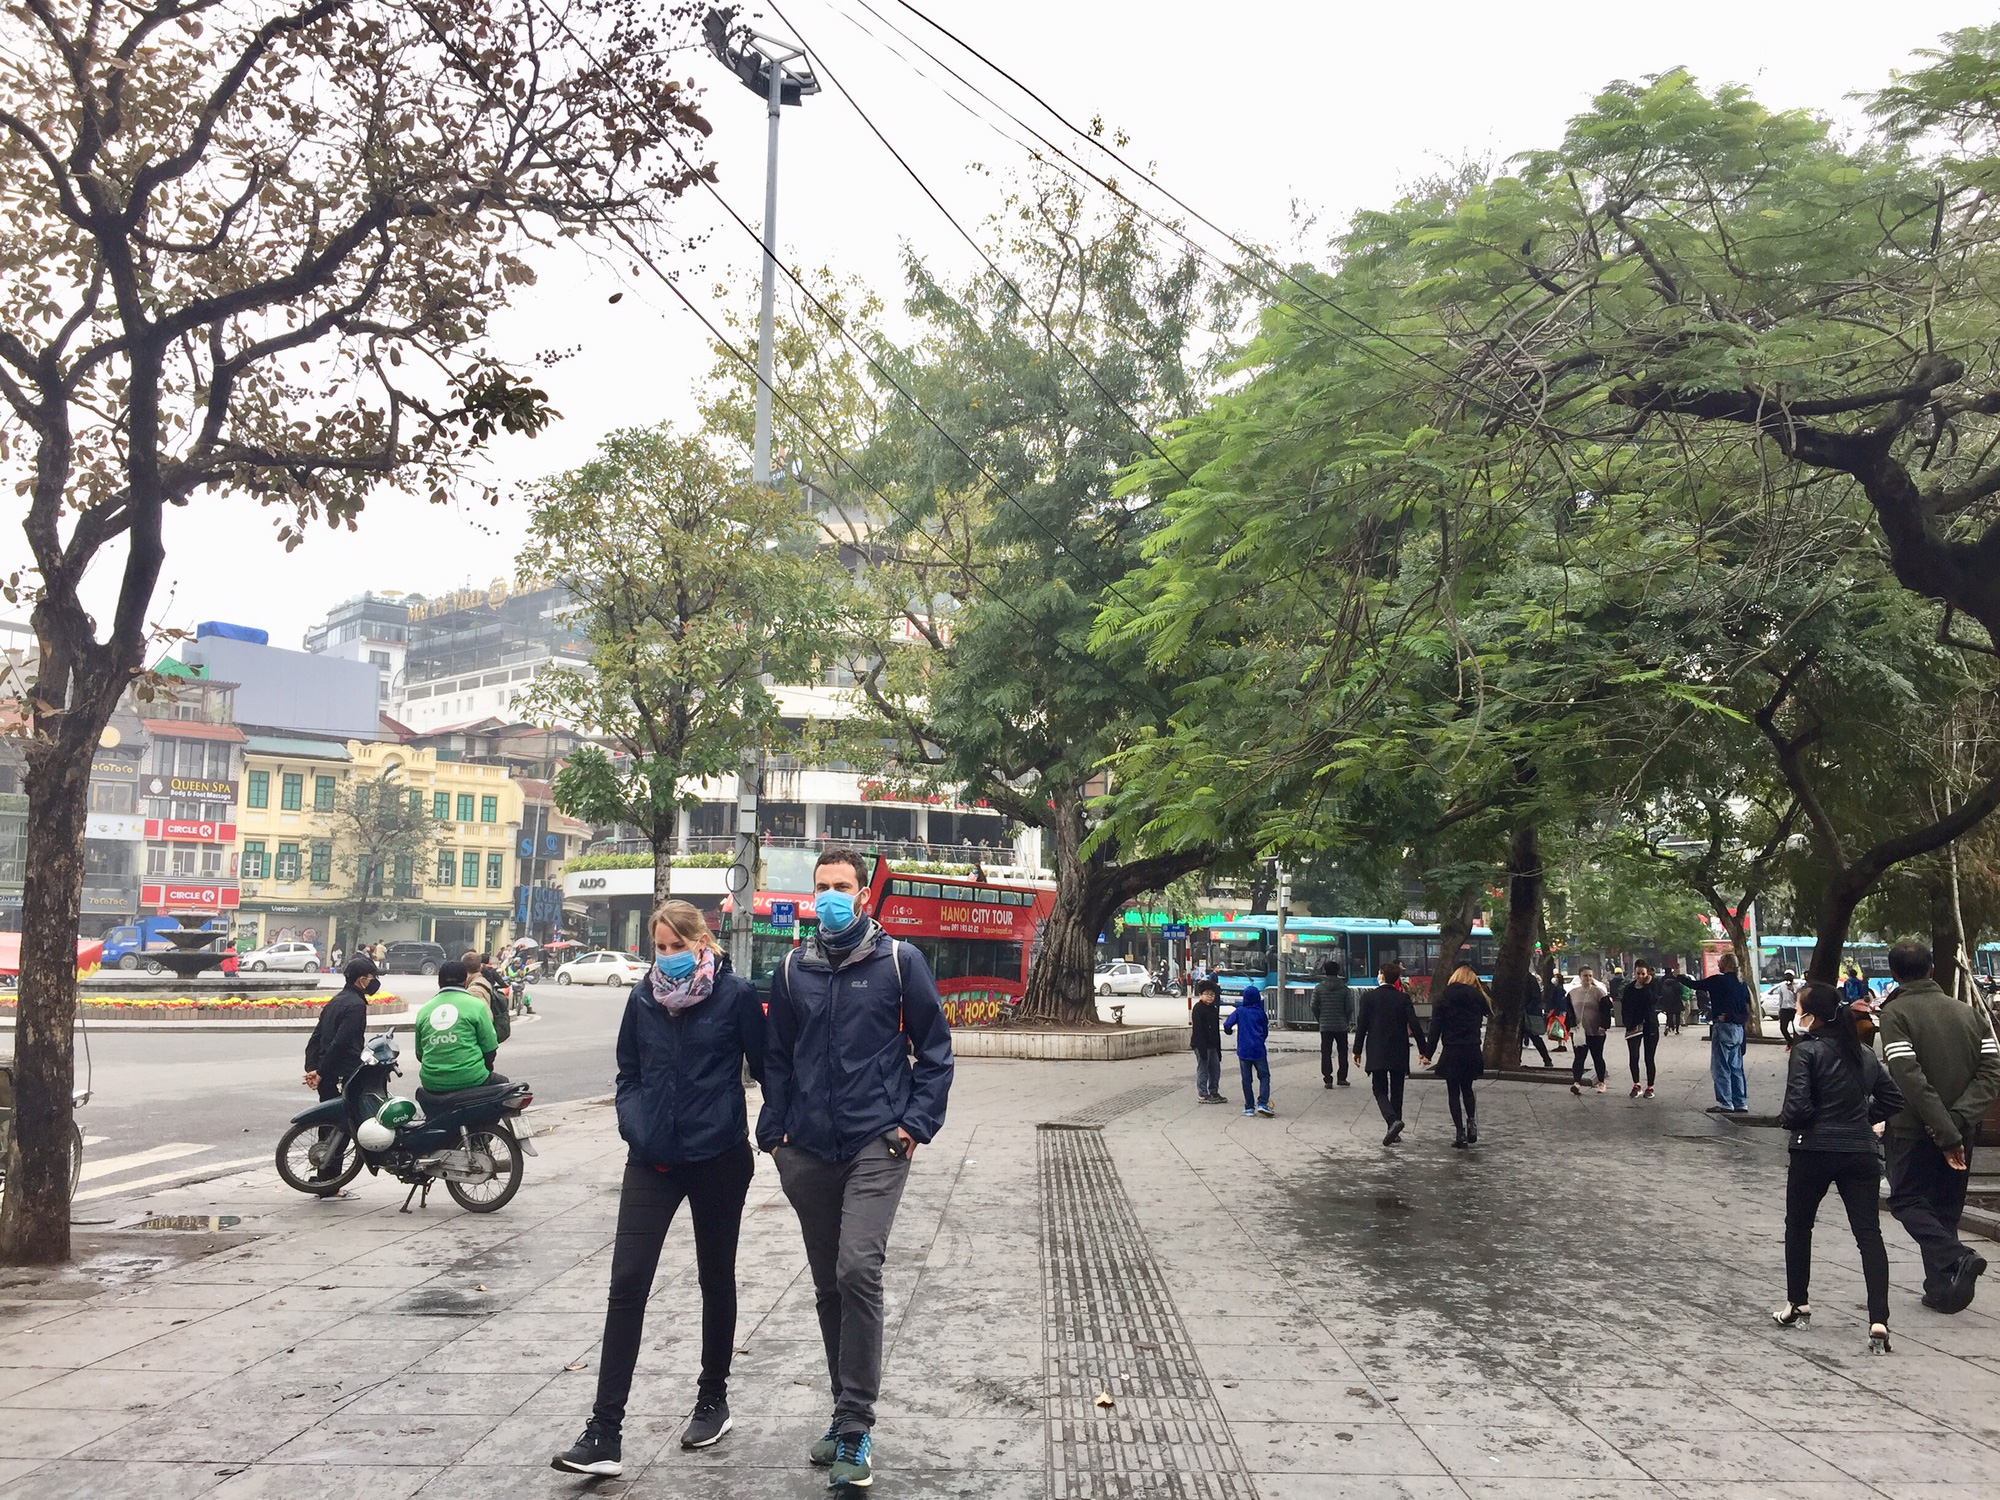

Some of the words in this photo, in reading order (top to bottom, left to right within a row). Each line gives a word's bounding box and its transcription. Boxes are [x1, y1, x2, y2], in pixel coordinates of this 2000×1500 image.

[171, 778, 209, 791] QUEEN
[212, 781, 231, 793] SPA
[206, 791, 231, 800] Massage
[167, 825, 198, 834] CIRCLE
[579, 877, 606, 889] ALDO
[170, 891, 200, 900] CIRCLE
[941, 906, 969, 922] HANOI
[972, 908, 991, 924] CITY
[992, 910, 1013, 925] TOUR
[965, 1002, 985, 1024] HOP
[429, 1032, 457, 1045] Grab
[392, 1113, 409, 1123] Grab
